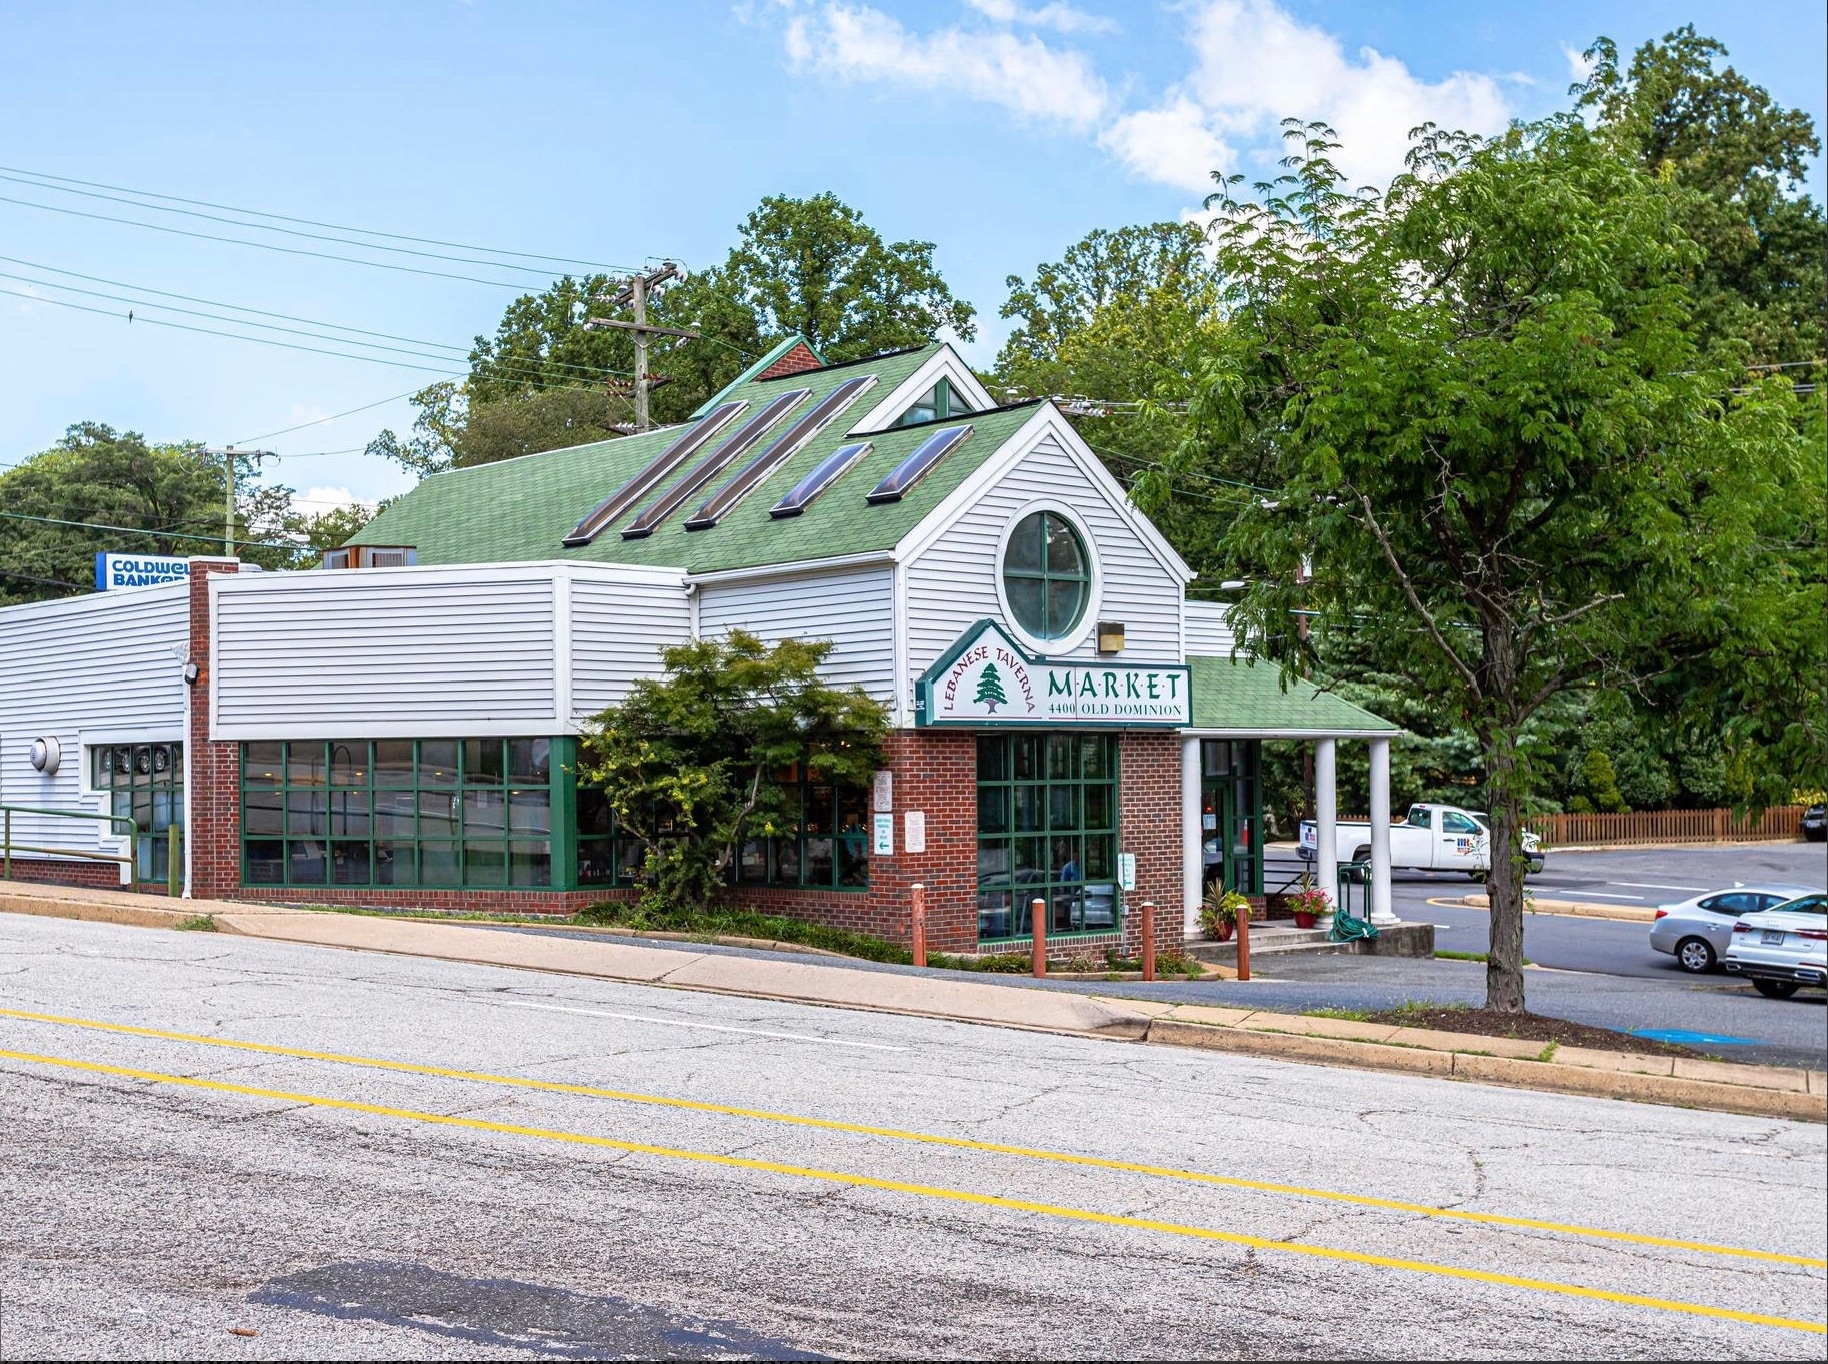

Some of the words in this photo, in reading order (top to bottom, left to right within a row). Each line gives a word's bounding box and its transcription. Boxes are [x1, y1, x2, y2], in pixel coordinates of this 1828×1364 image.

[944, 646, 989, 711] LEBANESE
[996, 647, 1036, 713] TAVERNA
[1048, 703, 1076, 714] 4400
[1081, 703, 1109, 715] OLD
[1114, 704, 1182, 716] DOMINION
